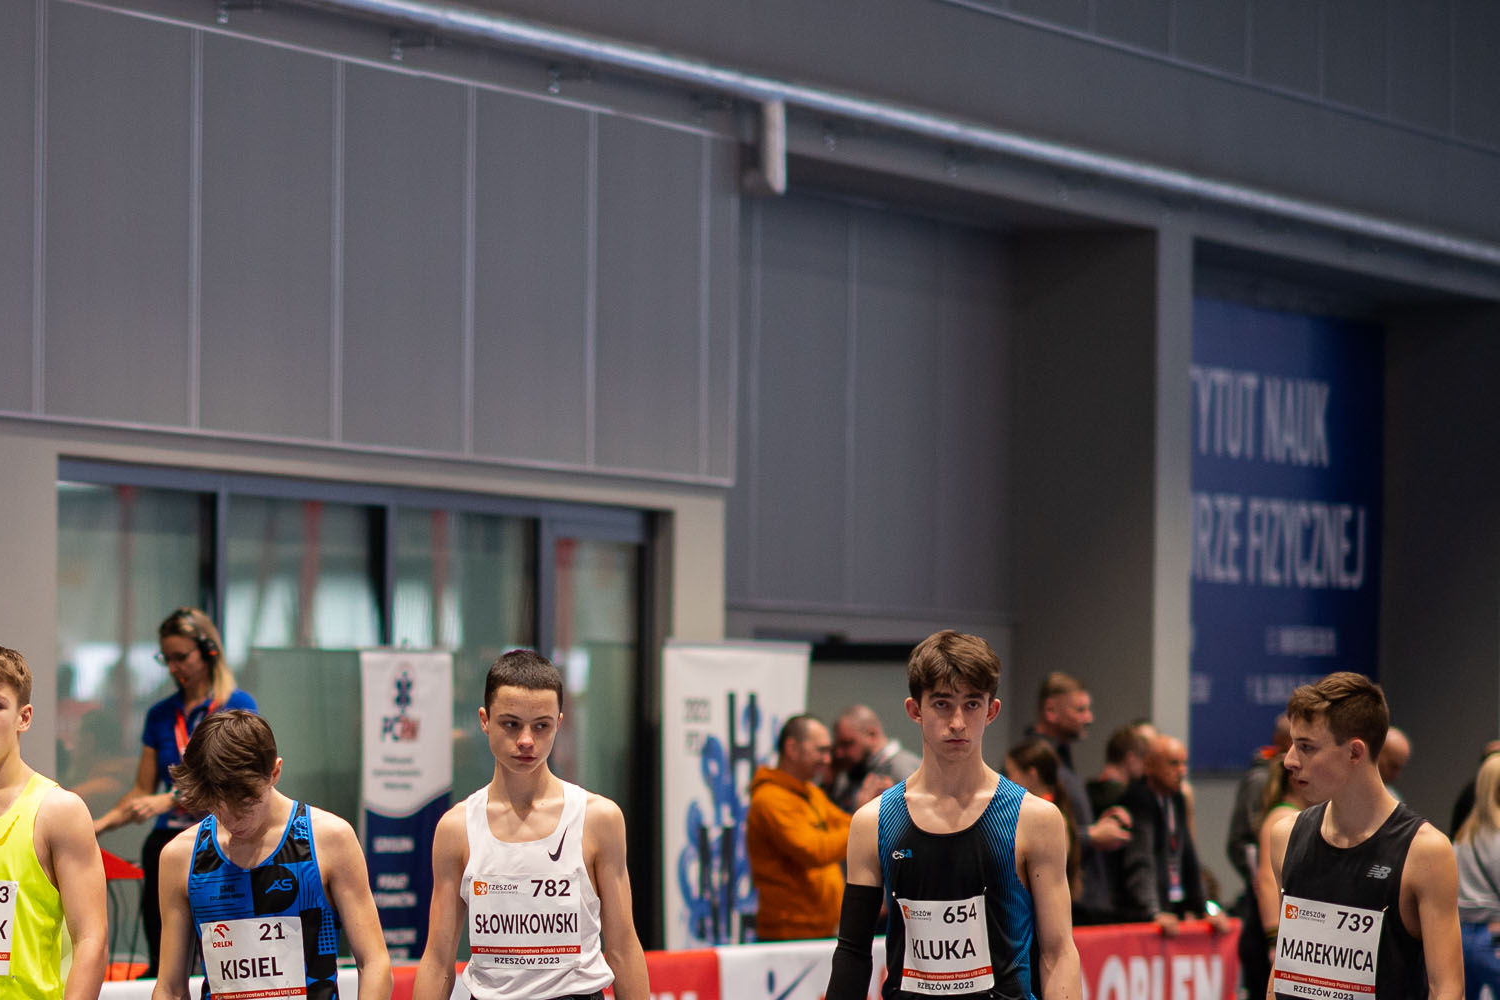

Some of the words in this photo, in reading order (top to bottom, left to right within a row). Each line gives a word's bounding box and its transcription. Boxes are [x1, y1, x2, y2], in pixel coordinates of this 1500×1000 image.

[1263, 375, 1331, 468] NAUK
[1246, 497, 1366, 590] FIZYCZNEJ
[530, 879, 571, 897] 782
[475, 912, 578, 934] SŁOWIKOWSKI
[943, 902, 977, 924] 654
[1336, 911, 1374, 933] 739
[259, 922, 286, 941] 21
[912, 937, 977, 961] KLUKA
[1280, 937, 1374, 972] MAREKWICA
[220, 956, 283, 981] KISIEL
[494, 956, 537, 965] RZESZÓW
[538, 957, 560, 965] 2023
[917, 981, 951, 990] RZESZÓW
[953, 981, 974, 990] 2023
[1293, 984, 1331, 998] RZESZÓW
[1333, 991, 1354, 1000] 2023
